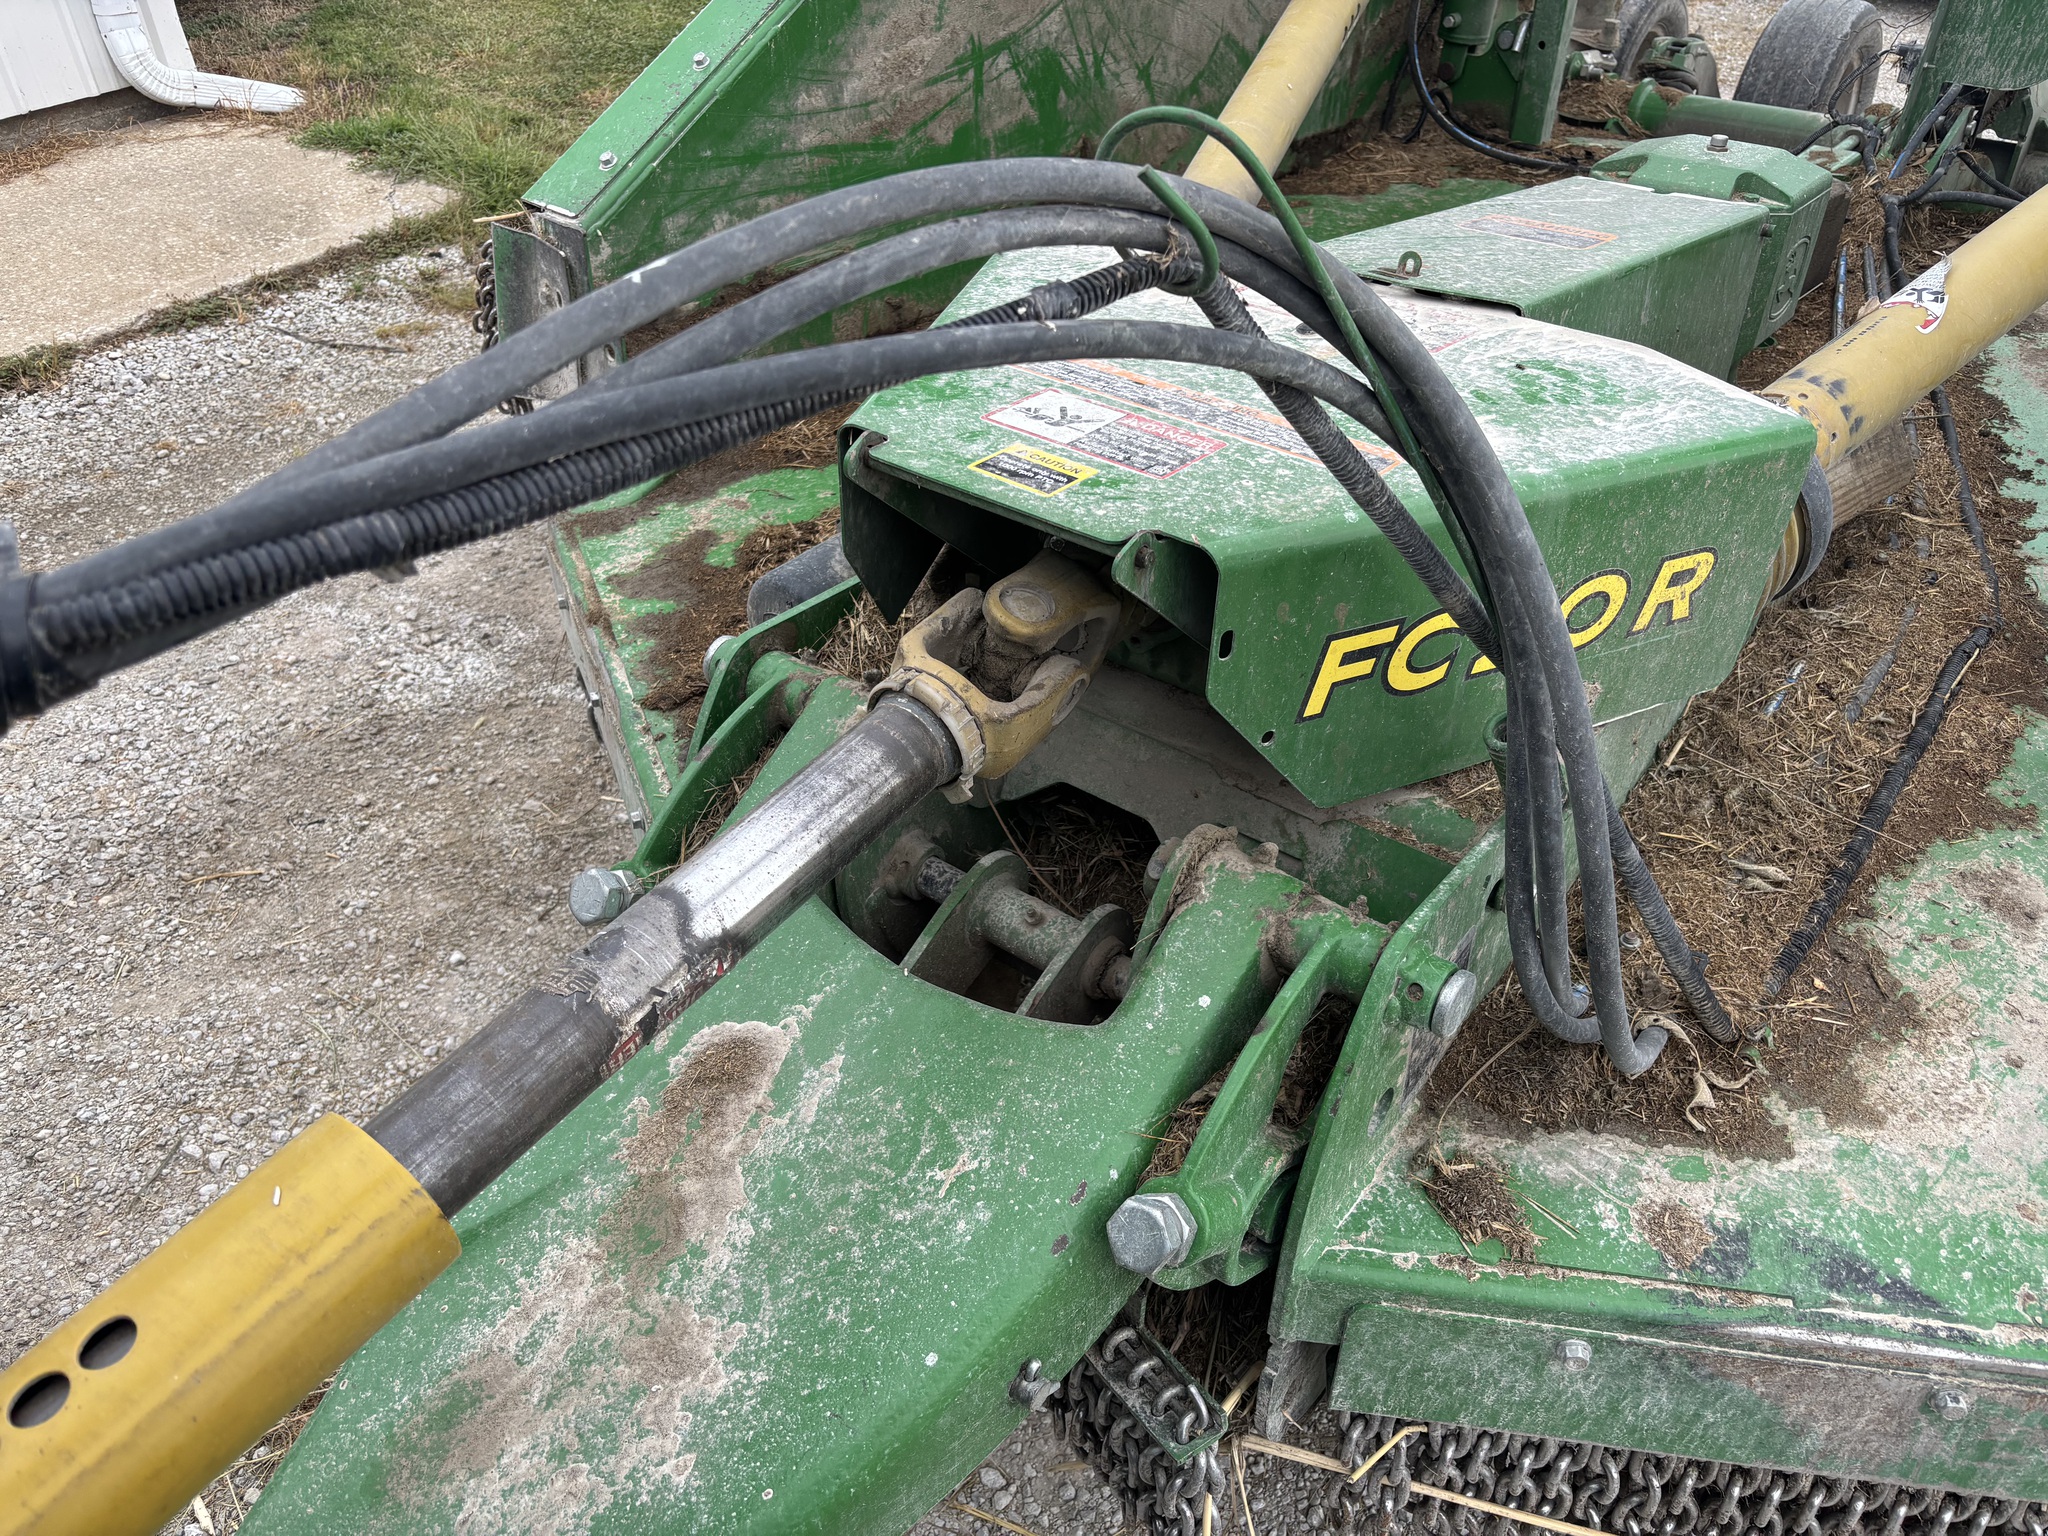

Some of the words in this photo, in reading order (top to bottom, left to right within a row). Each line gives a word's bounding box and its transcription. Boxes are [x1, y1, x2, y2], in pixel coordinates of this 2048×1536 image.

[1144, 423, 1214, 451] DANGER
[998, 455, 1032, 470] Operate
[1050, 472, 1068, 483] with
[1017, 467, 1034, 479] rpm
[1035, 474, 1054, 484] PTO
[1029, 453, 1083, 475] CAUTION
